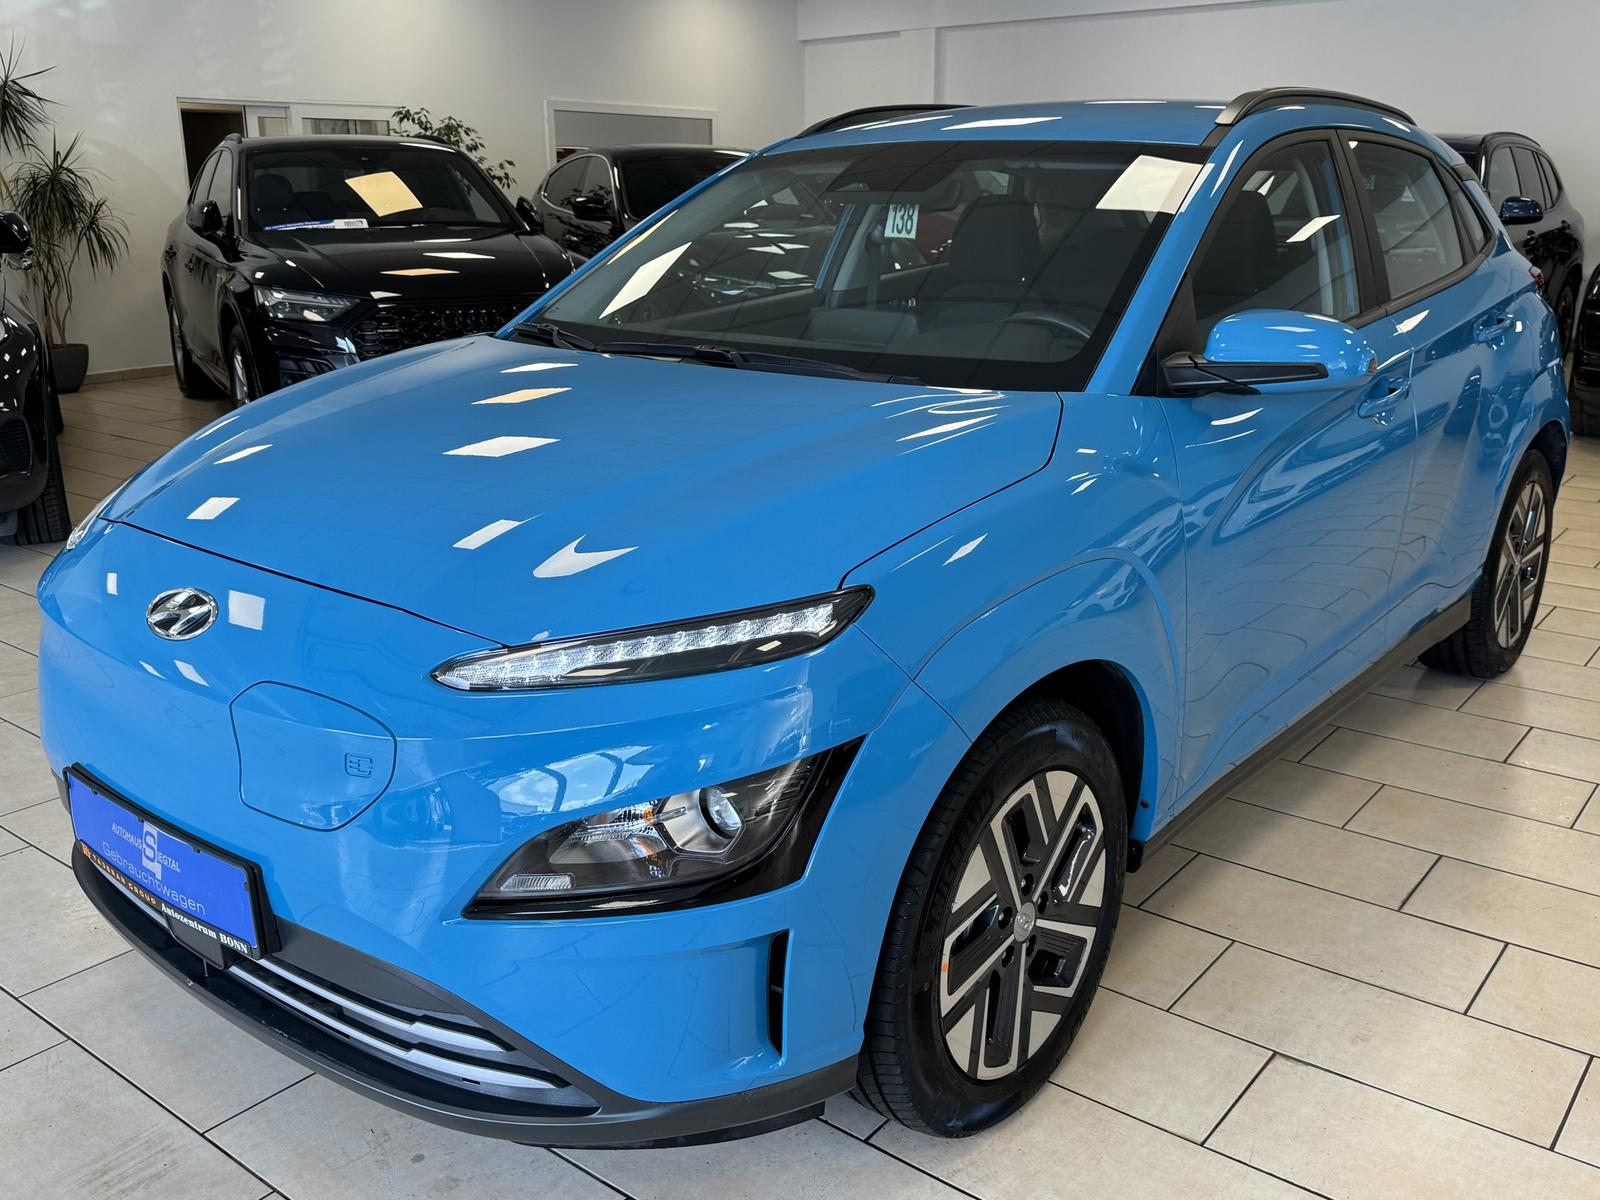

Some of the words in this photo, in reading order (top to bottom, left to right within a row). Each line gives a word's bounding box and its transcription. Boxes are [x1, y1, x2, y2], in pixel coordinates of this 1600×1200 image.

[891, 204, 915, 236] 138
[112, 821, 144, 850] AUTOHAUS
[102, 841, 206, 916] Gebrauchtwagen
[161, 902, 218, 940] Autozentrum
[219, 932, 249, 955] BONN
